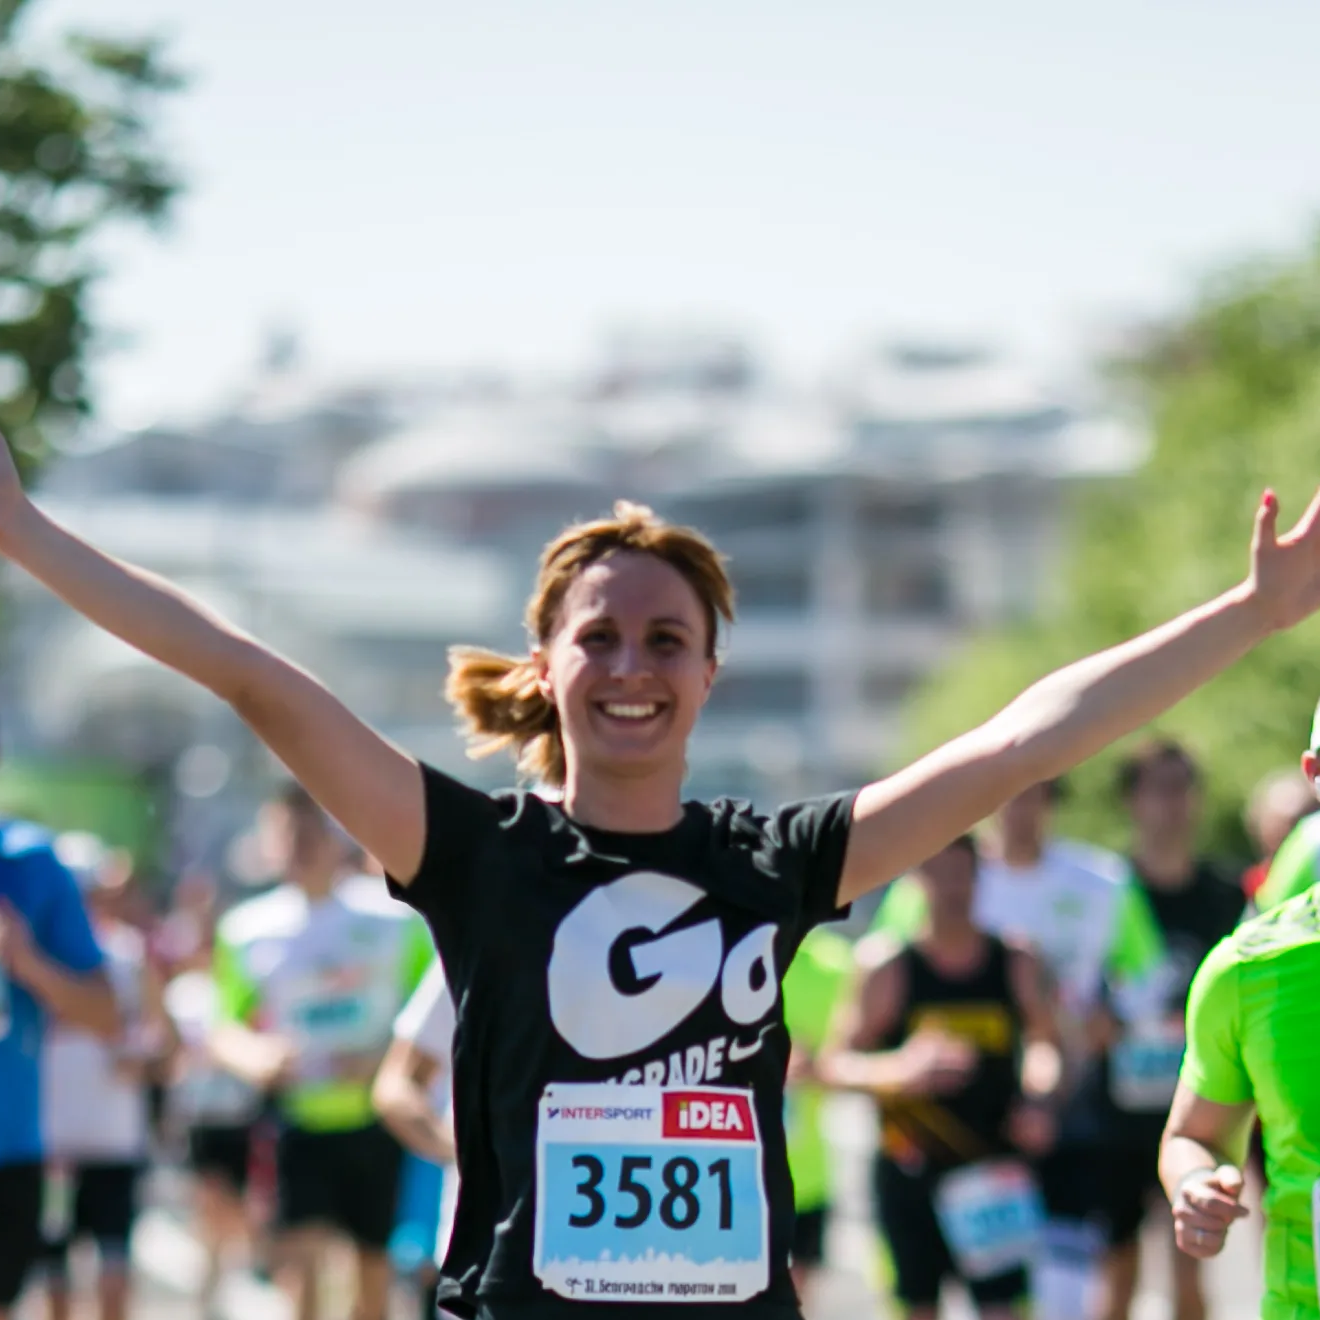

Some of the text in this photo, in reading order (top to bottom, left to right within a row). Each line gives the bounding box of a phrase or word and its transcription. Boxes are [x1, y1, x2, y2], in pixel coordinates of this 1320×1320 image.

[547, 870, 778, 1060] Go
[561, 1107, 653, 1121] INTERSPORT
[679, 1101, 744, 1132] iDEA
[568, 1154, 734, 1231] 3581
